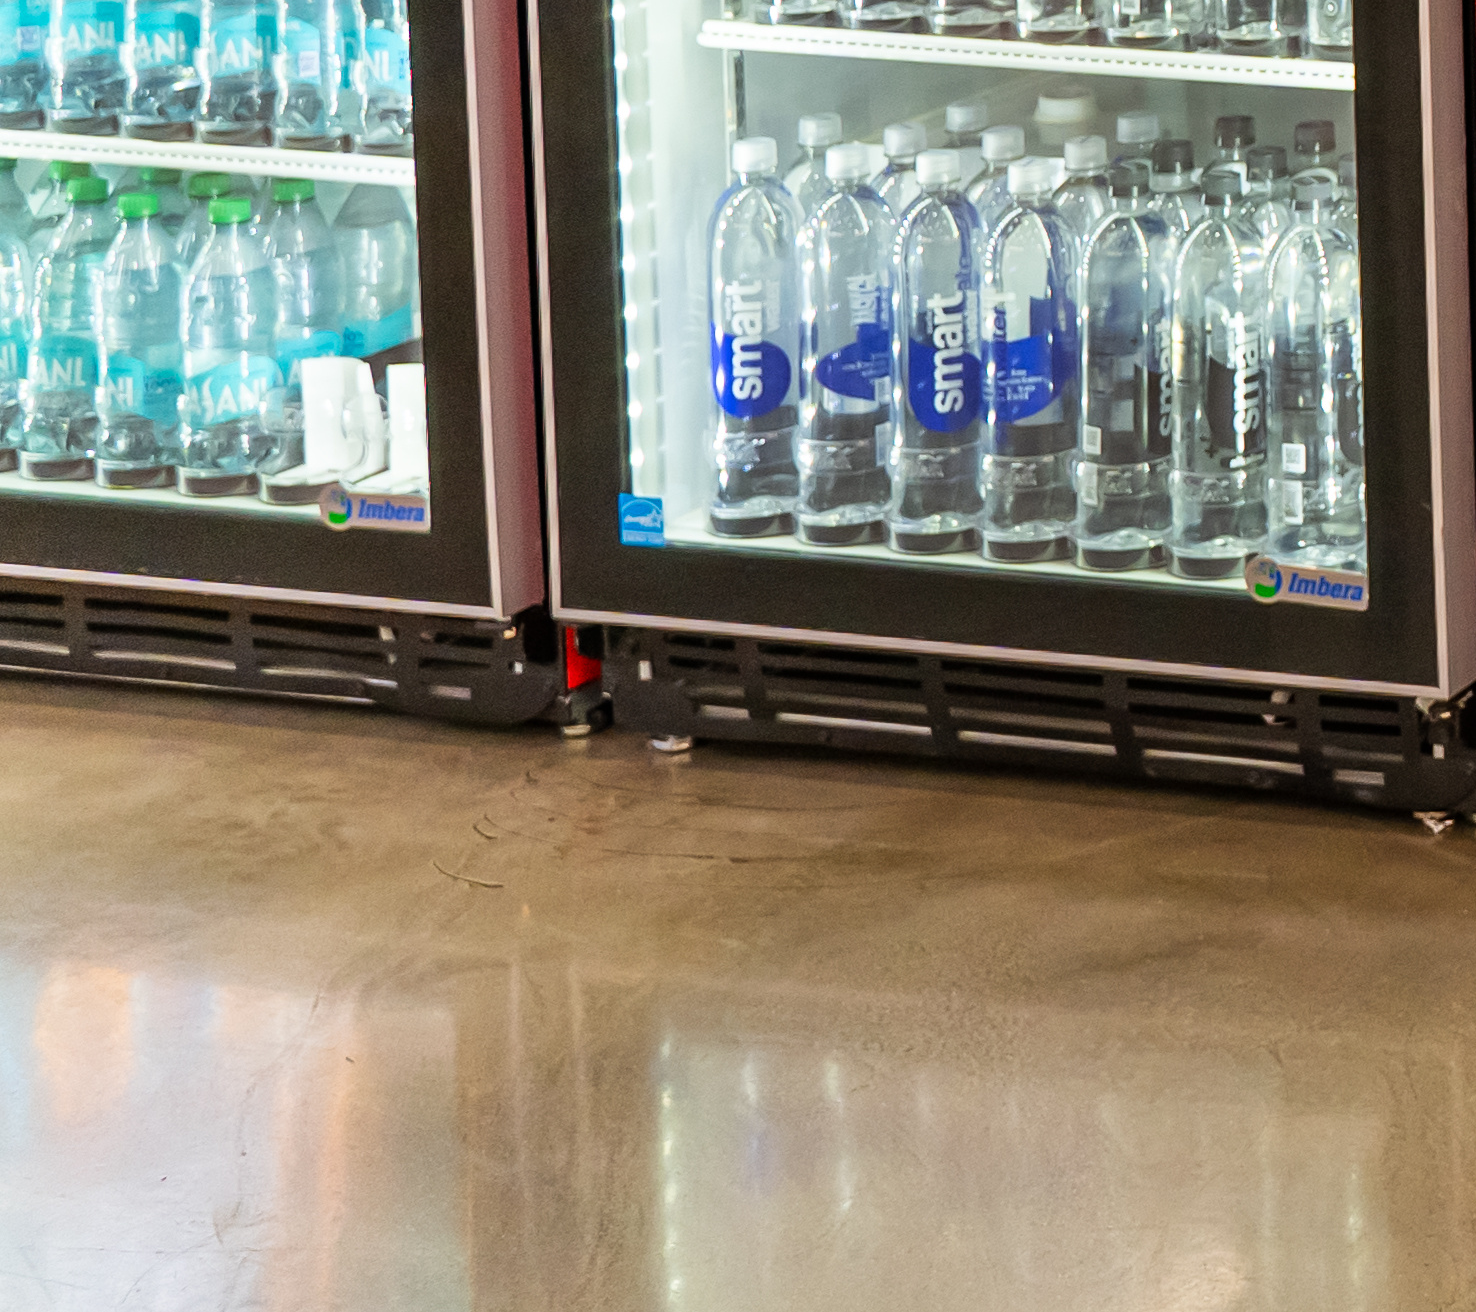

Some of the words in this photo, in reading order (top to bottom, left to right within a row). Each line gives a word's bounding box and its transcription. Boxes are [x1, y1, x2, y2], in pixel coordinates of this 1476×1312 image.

[730, 278, 764, 402] smart
[931, 291, 964, 413] smart
[356, 495, 427, 524] Imbera
[1286, 571, 1364, 603] Imbera
